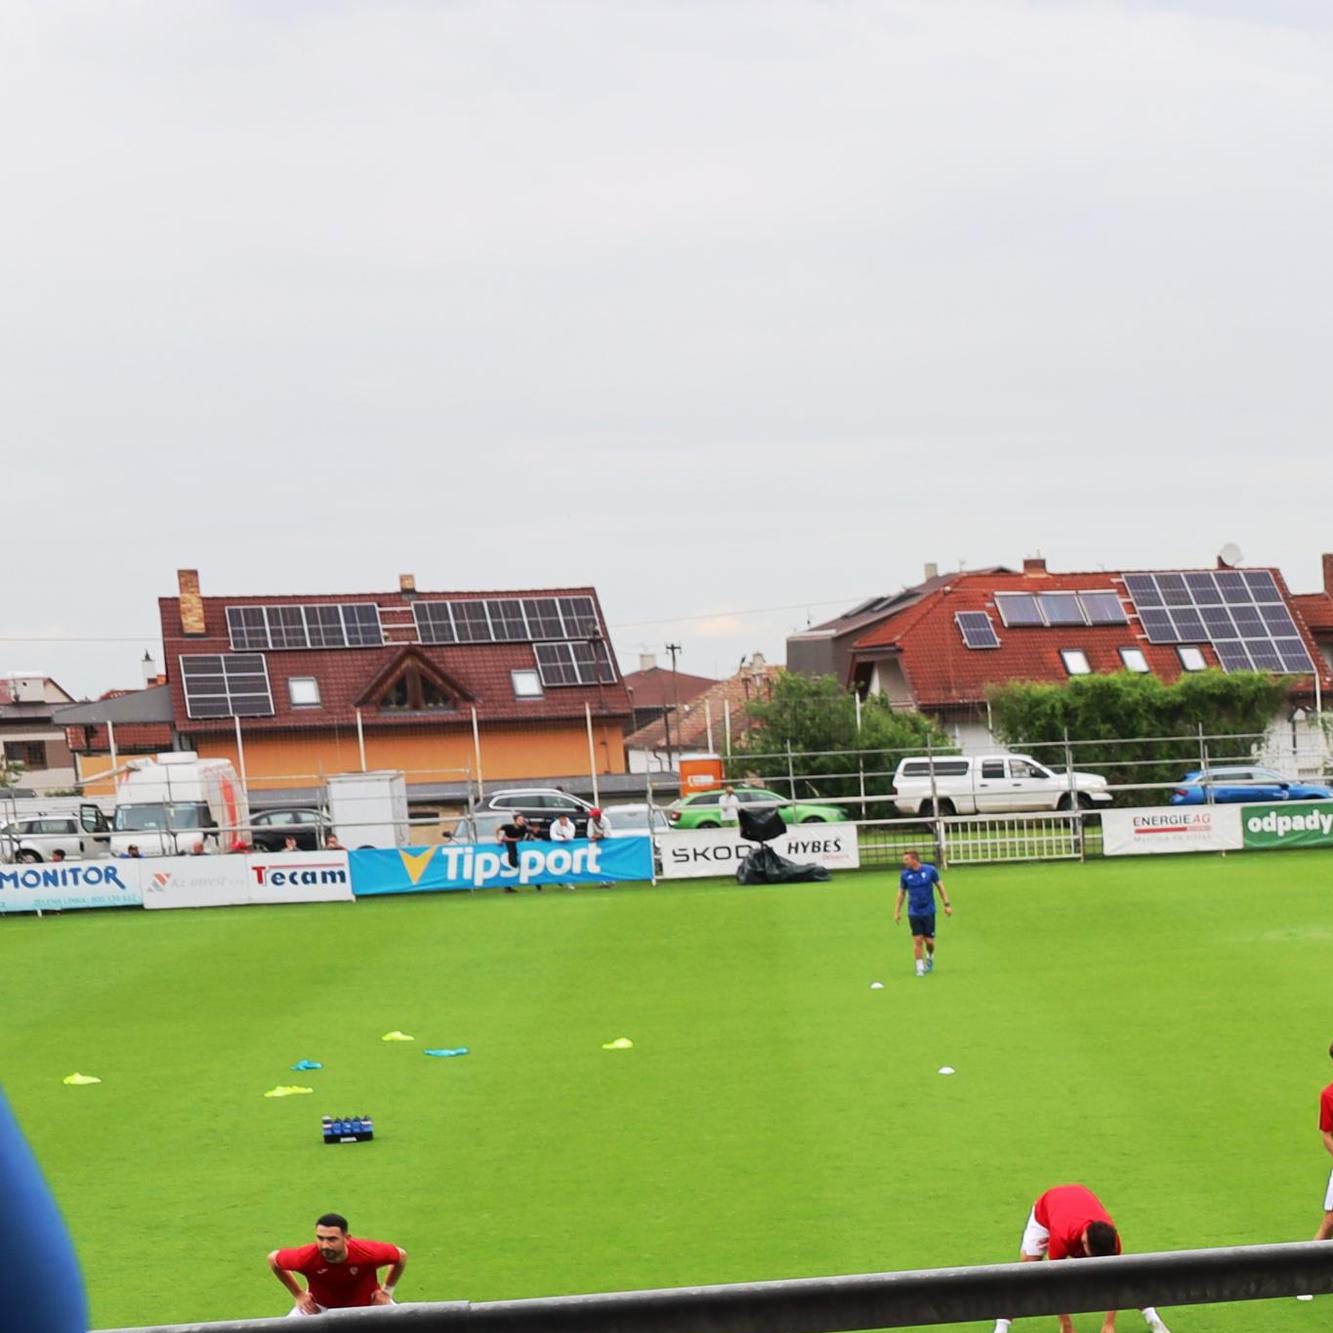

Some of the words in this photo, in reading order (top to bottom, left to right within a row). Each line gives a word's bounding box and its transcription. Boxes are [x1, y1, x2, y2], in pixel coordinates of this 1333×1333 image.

[1247, 808, 1333, 837] odpady
[672, 845, 755, 863] ŠKOD
[788, 837, 842, 855] HYBEŠ
[441, 842, 602, 886] Tipsport
[251, 866, 347, 887] Tecam
